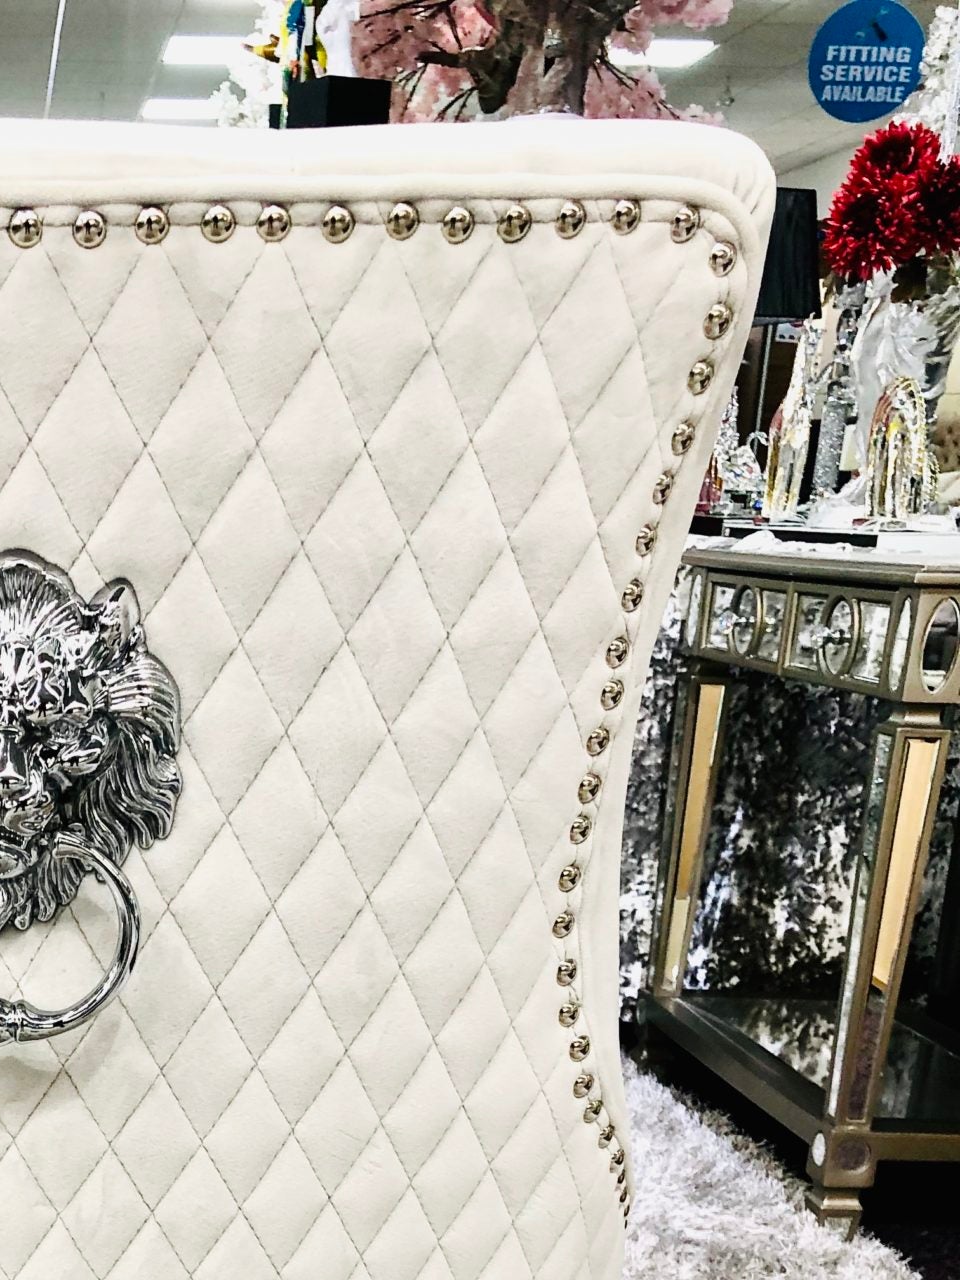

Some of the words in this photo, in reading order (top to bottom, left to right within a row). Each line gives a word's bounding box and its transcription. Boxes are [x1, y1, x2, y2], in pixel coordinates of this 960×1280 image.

[826, 45, 912, 63] FITTING
[820, 64, 912, 82] SERVICE
[821, 85, 905, 103] AVAILABLE
